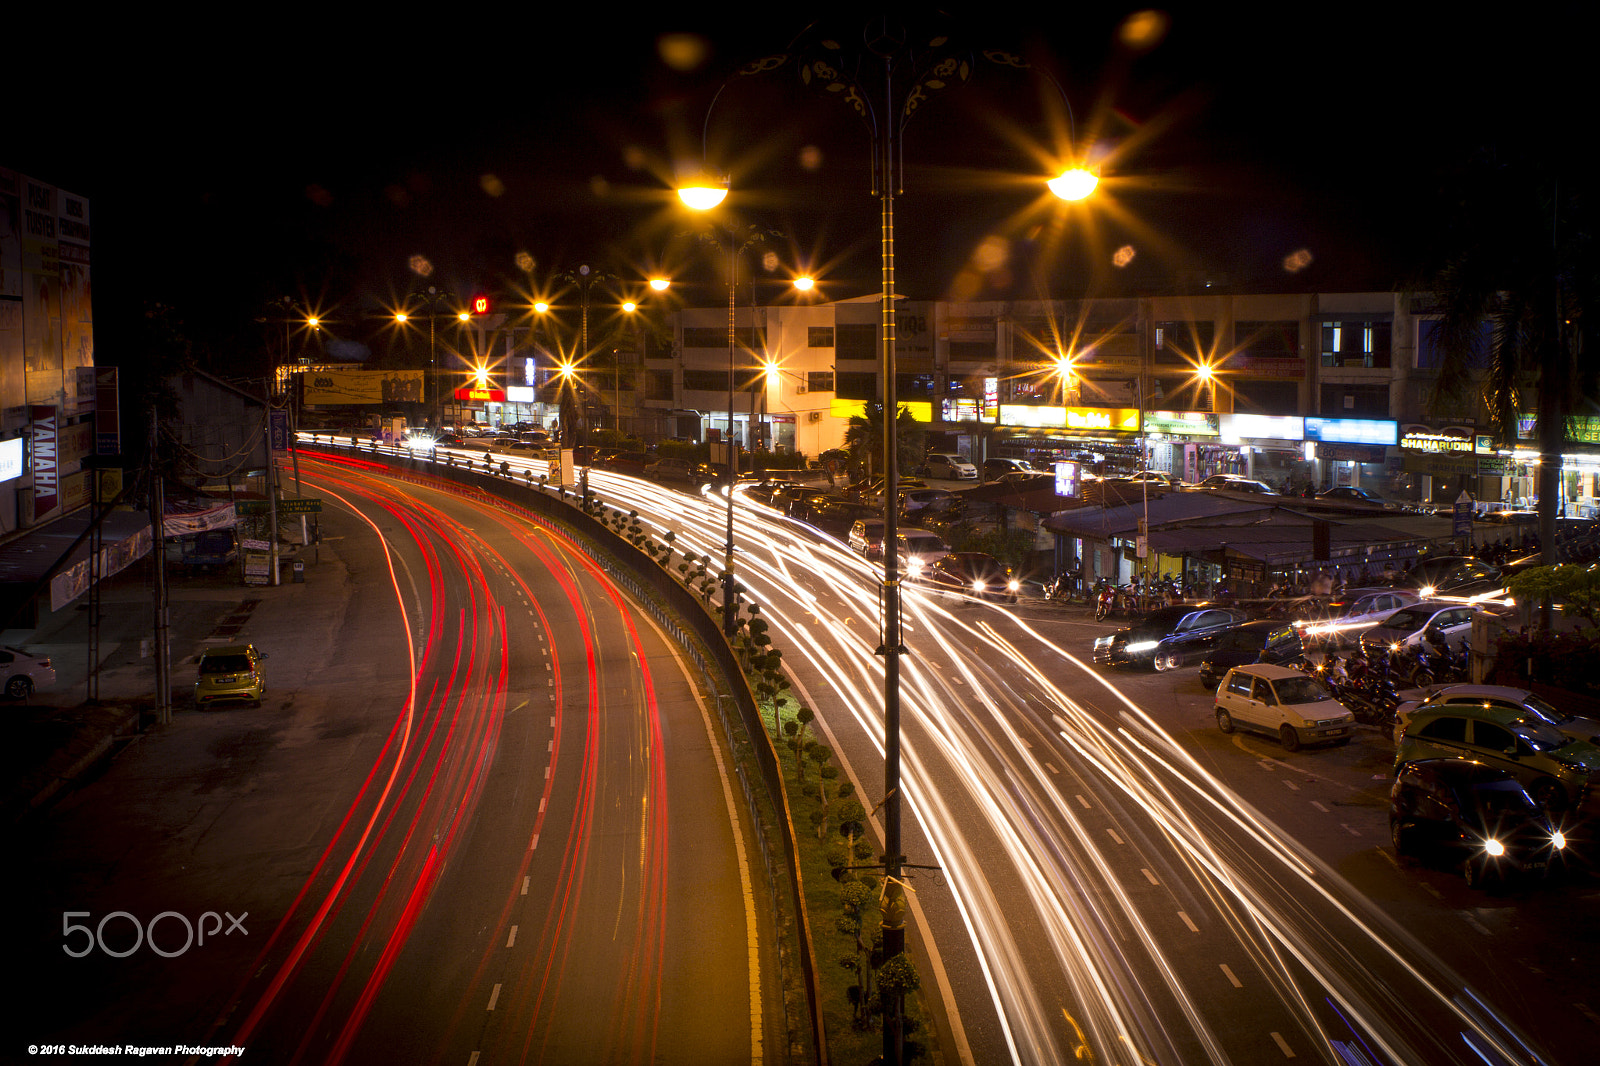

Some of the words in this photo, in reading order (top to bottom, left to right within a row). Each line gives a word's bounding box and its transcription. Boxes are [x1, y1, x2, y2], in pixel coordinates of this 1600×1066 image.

[28, 182, 50, 211] PUSAT
[25, 209, 56, 238] TUISYEN
[34, 416, 57, 498] YAMAHA
[1401, 439, 1473, 451] SHAHARUDIN
